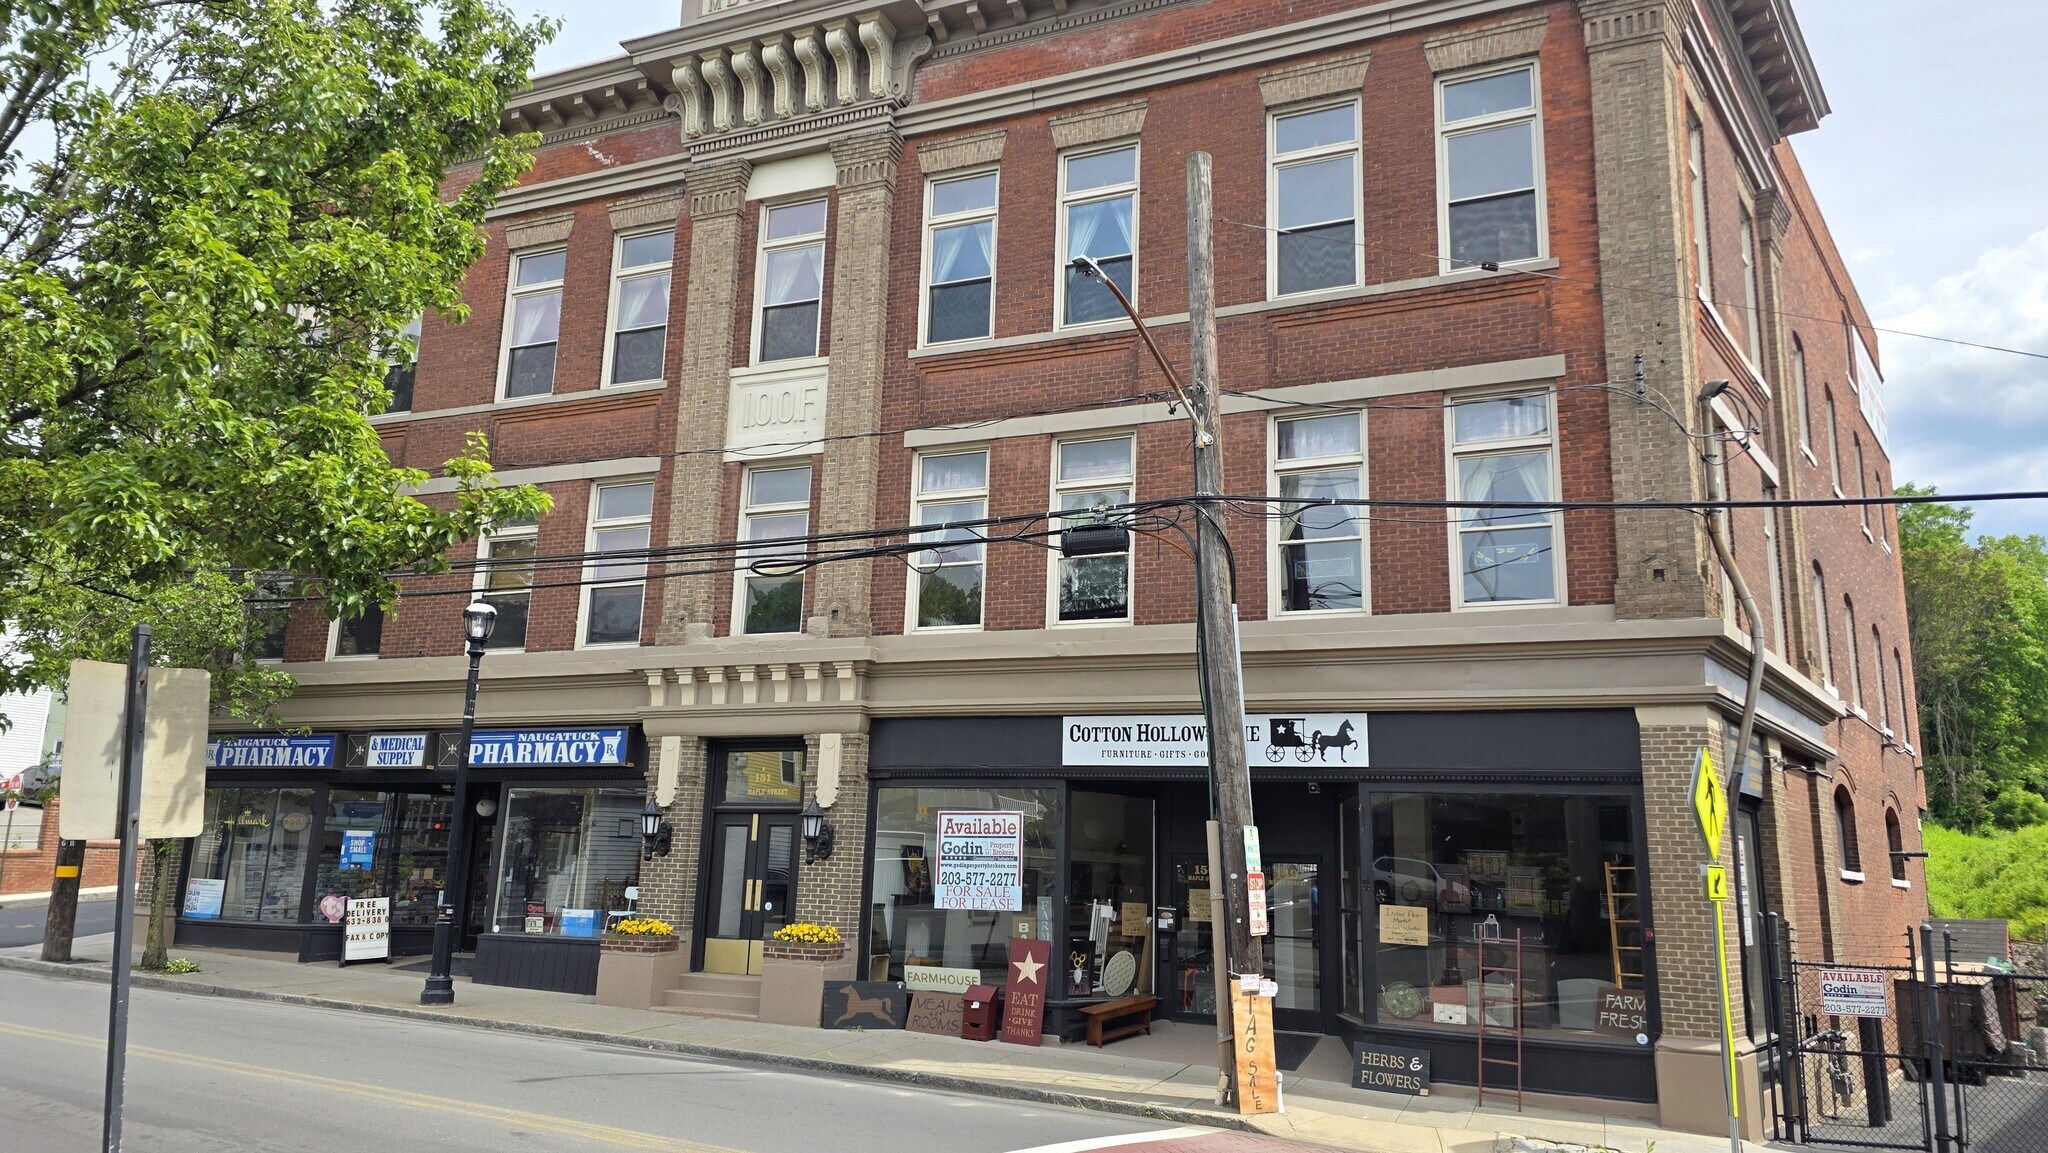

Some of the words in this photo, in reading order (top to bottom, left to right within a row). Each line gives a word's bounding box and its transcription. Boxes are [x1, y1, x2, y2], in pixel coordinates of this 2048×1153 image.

[517, 731, 600, 742] NAUGATUCK
[371, 741, 378, 750] &
[379, 737, 424, 751] MEDICAL
[220, 747, 330, 767] PHARMACY
[376, 751, 415, 766] SUPPLY
[469, 742, 600, 764] PHARMACY
[1101, 750, 1152, 758] FURNITURE
[1159, 750, 1186, 758] GIFTS
[747, 788, 766, 796] MAPLE
[766, 788, 789, 796] STREET
[944, 818, 1017, 835] Available
[349, 846, 367, 854] SMALL
[941, 841, 984, 855] Godin
[990, 841, 1015, 850] Property
[992, 848, 1015, 856] Brokers
[941, 871, 1017, 887] 203-577-2277
[1249, 878, 1264, 890] STOP
[945, 885, 971, 897] FOR
[976, 886, 1011, 898] SALE
[355, 901, 376, 909] FREE
[941, 897, 967, 909] FOR
[972, 897, 1015, 910] LEASE
[346, 908, 386, 917] DELIVERY
[346, 934, 360, 942] FAX
[907, 971, 979, 986] FARMHOUSE
[1823, 972, 1882, 983] AVAILABLE
[1824, 984, 1857, 994] Godin
[914, 997, 964, 1014] MEALS
[1606, 994, 1646, 1011] FARM
[1824, 1004, 1885, 1014] 203-577-2277
[912, 1014, 959, 1032] ROOMS
[1242, 990, 1260, 1053] TAG
[1006, 1026, 1035, 1038] THANKS
[1361, 1051, 1405, 1069] HERBS
[1410, 1057, 1423, 1071] &
[1247, 1061, 1263, 1110] SALE
[1361, 1070, 1421, 1090] FLOWERS
